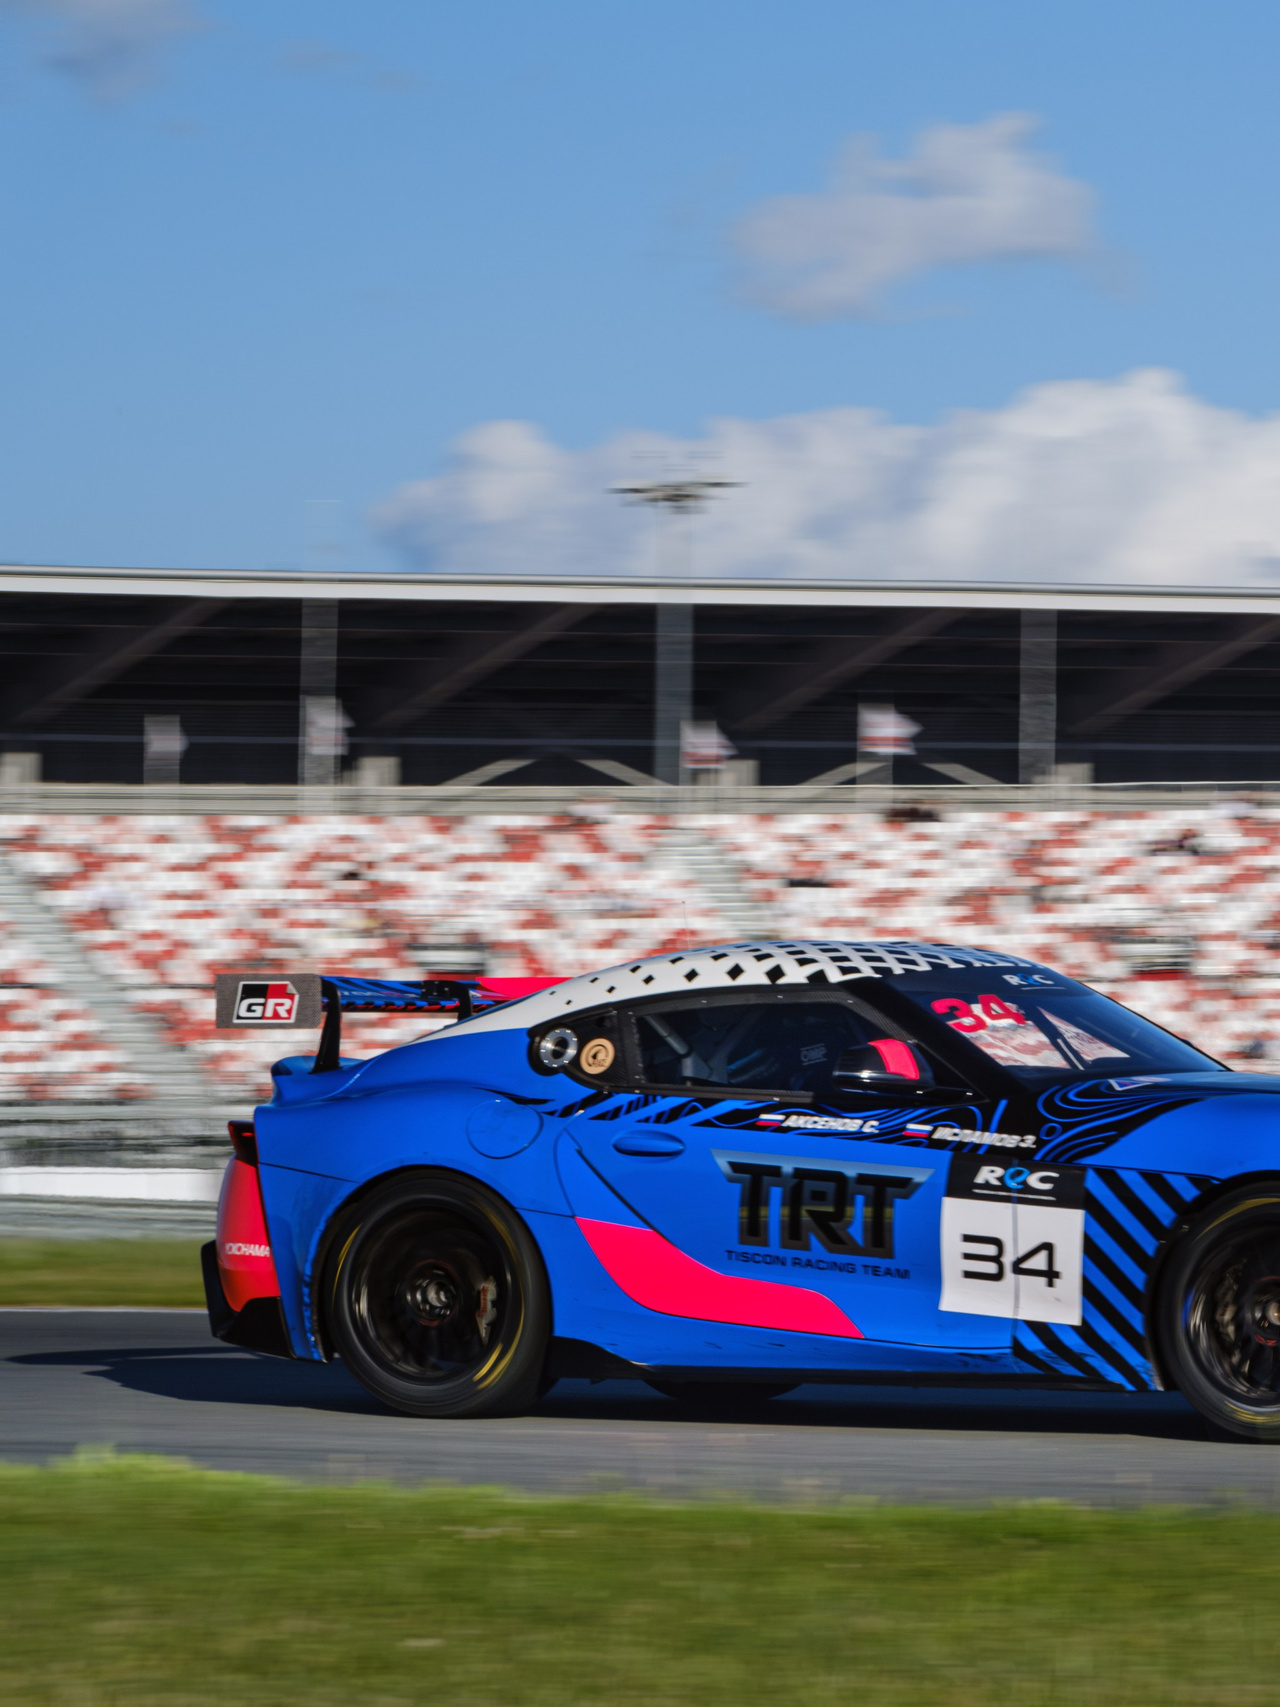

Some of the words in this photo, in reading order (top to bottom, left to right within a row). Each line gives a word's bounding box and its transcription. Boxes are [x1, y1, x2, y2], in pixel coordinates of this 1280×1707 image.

[238, 998, 292, 1018] GR
[930, 994, 1027, 1033] 34
[711, 1150, 934, 1259] TRT
[725, 1250, 787, 1267] TISCON
[791, 1257, 857, 1274] RACING
[861, 1264, 911, 1280] TEAM
[962, 1234, 1061, 1288] 34
